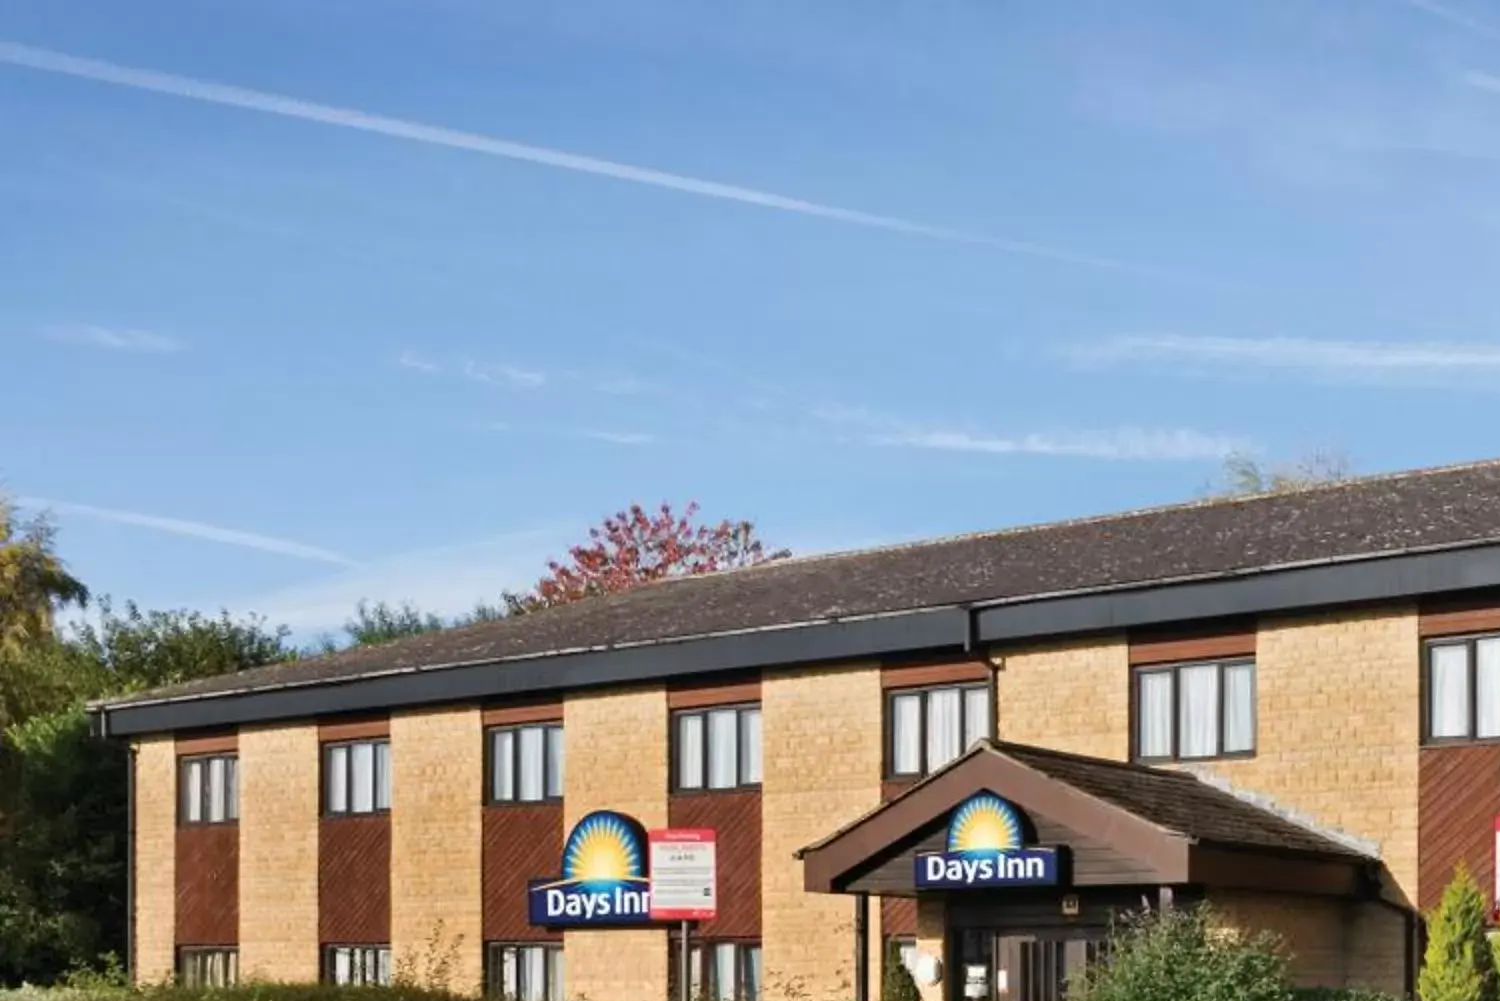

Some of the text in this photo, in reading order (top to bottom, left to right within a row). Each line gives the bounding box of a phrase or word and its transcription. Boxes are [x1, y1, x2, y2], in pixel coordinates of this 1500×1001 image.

[927, 853, 1045, 884] Days Inn
[547, 889, 611, 919] Days
